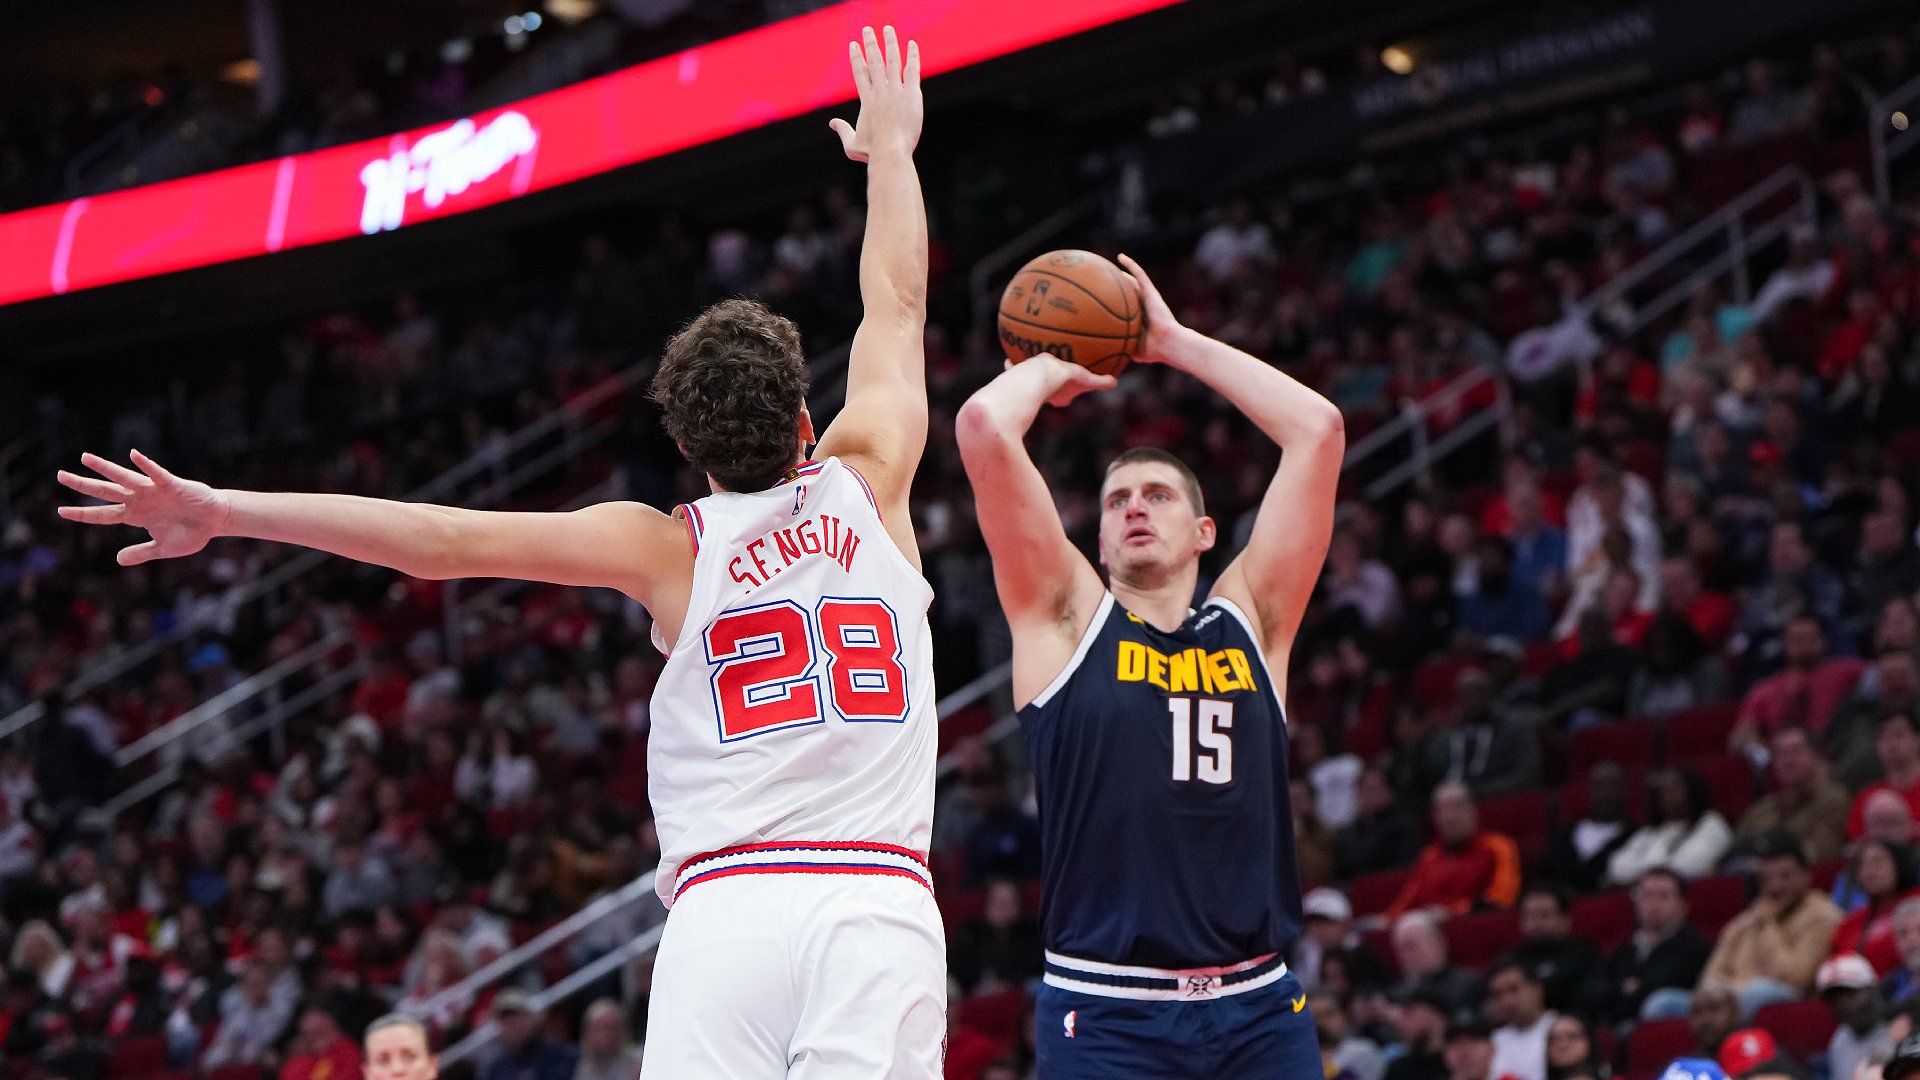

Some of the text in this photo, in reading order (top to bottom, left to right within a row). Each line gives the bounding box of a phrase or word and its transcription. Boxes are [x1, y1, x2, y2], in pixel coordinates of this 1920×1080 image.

[729, 514, 861, 595] SENGUN
[702, 595, 911, 744] 28
[1168, 697, 1233, 785] 15
